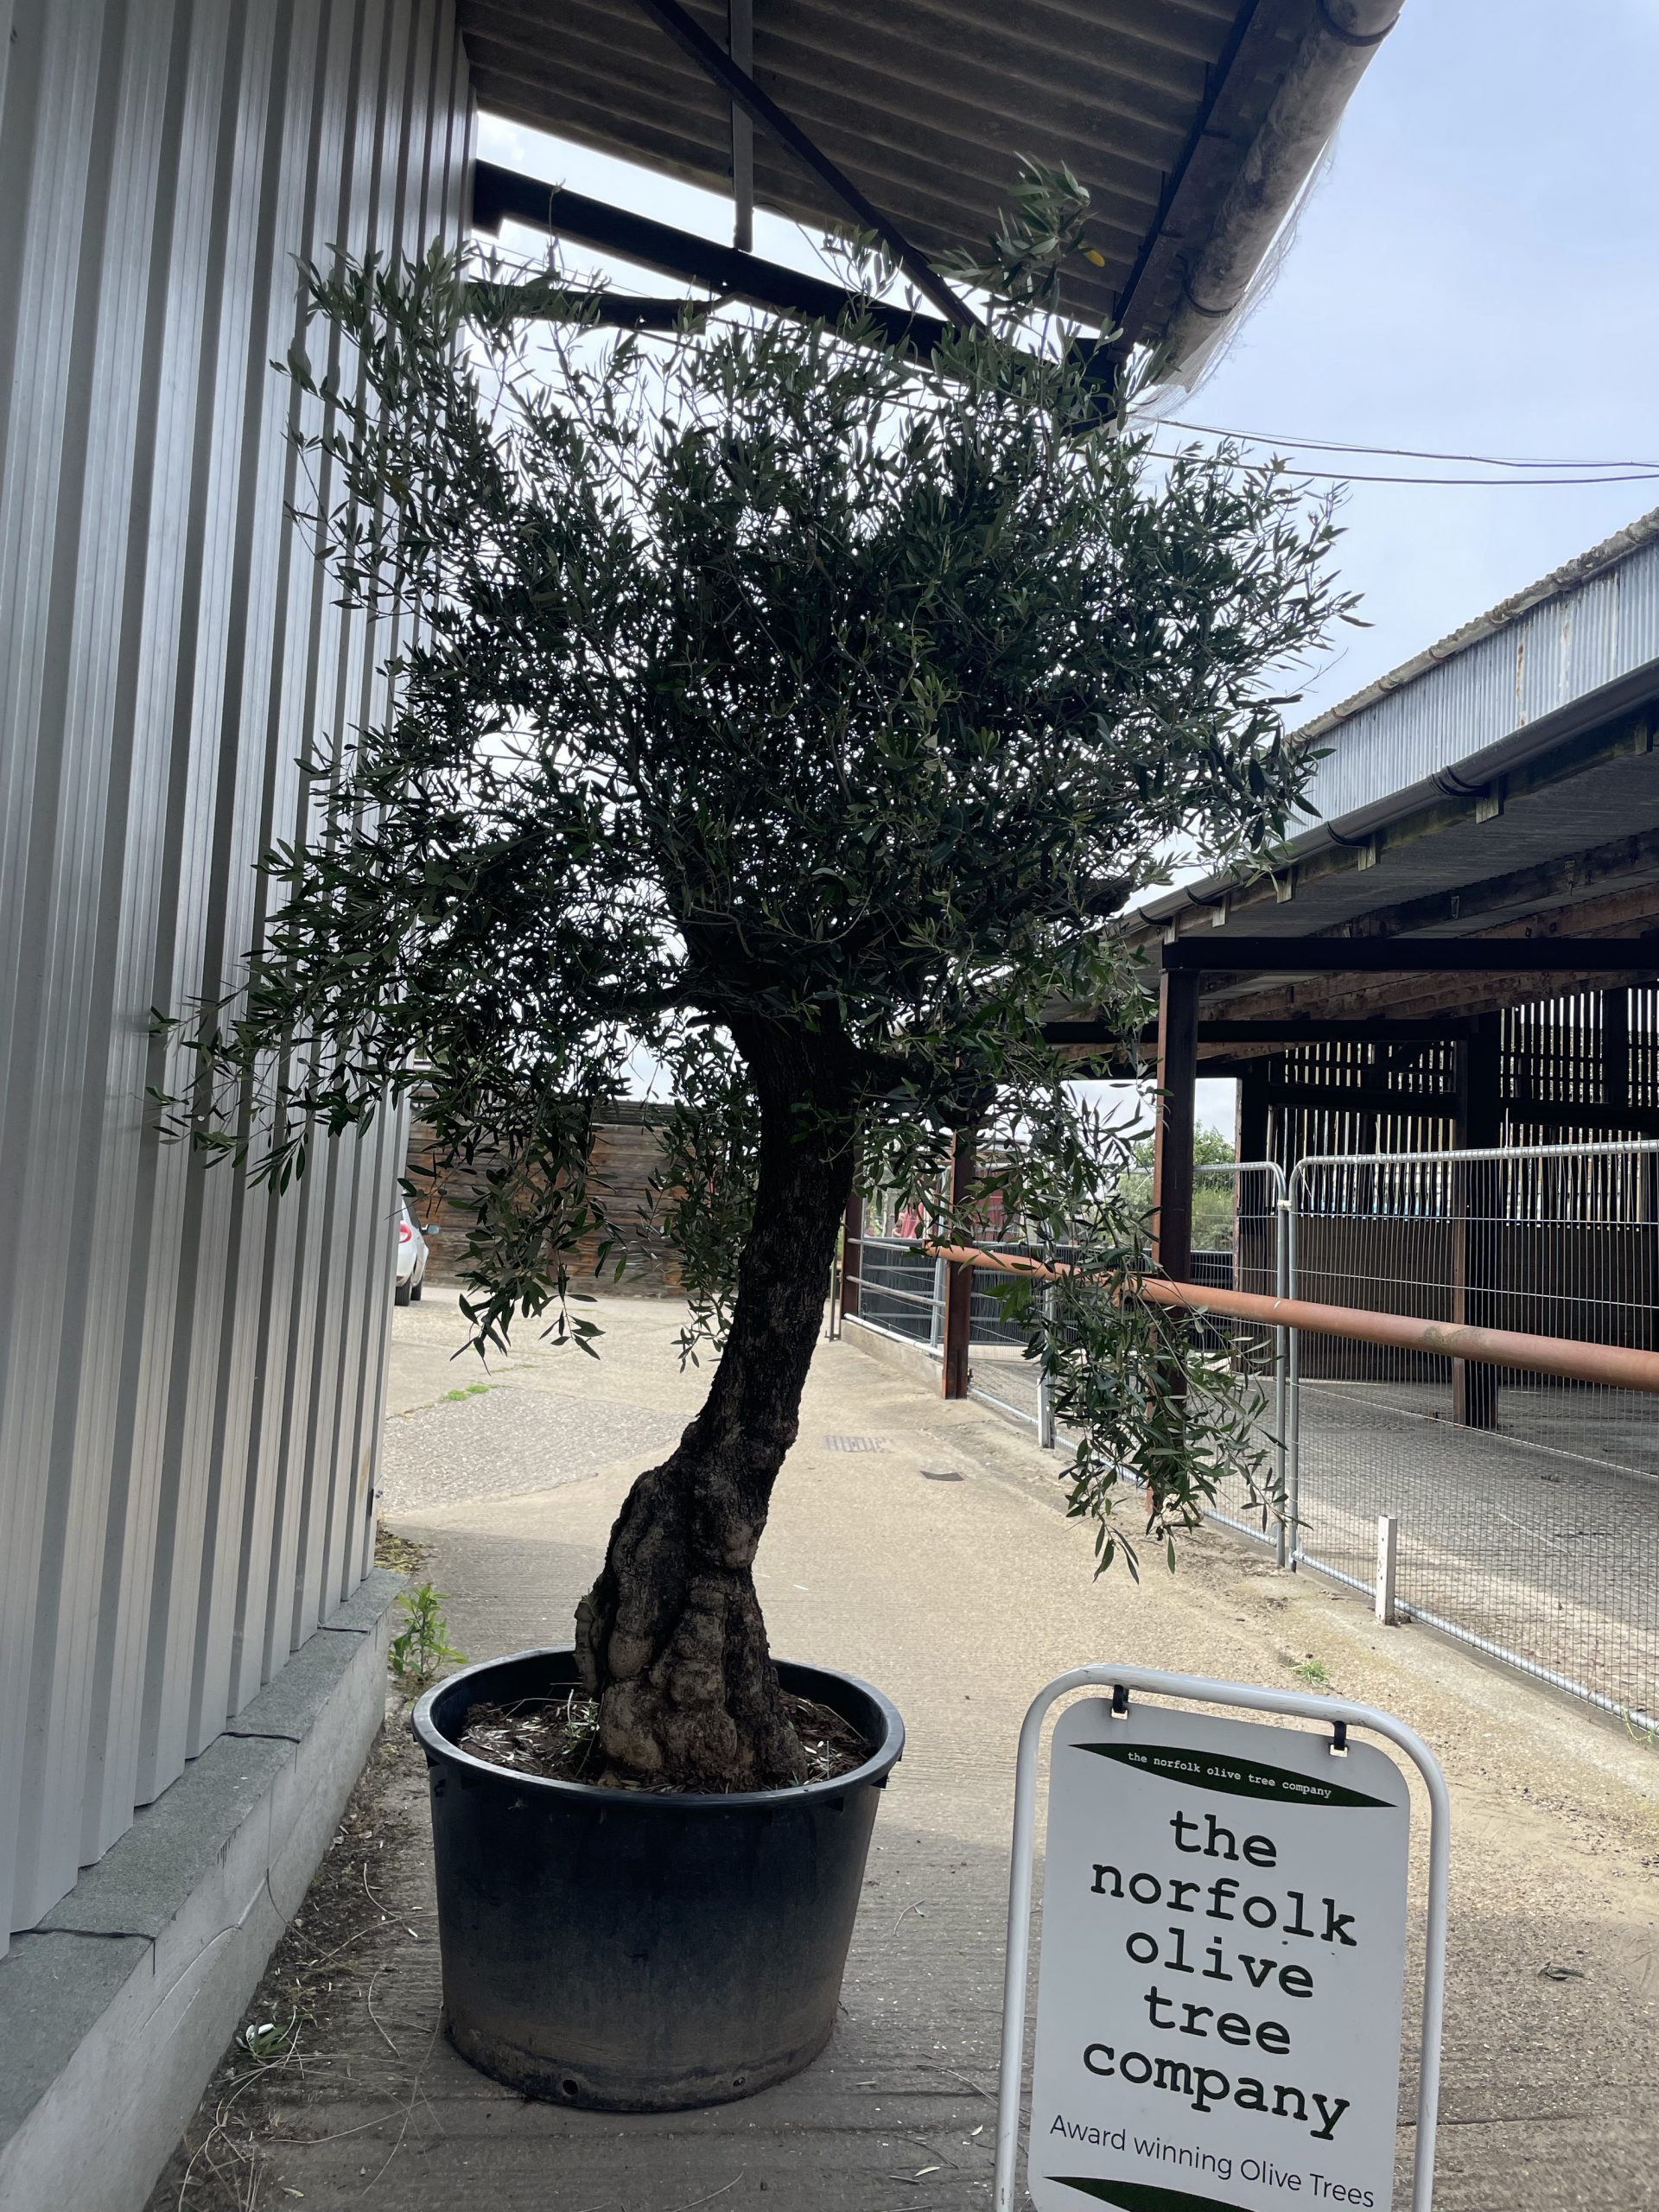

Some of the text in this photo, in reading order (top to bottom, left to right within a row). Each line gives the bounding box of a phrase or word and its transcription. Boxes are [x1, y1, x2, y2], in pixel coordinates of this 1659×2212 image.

[1128, 1751, 1332, 1798] the norfolk olive tree company
[1170, 1810, 1277, 1867] the
[1090, 1864, 1357, 1947] norfolk
[1126, 1927, 1313, 1998] olive
[1144, 1986, 1291, 2054] tree
[1083, 2043, 1351, 2141] company
[1050, 2114, 1374, 2208] Award winning Olive Trees
